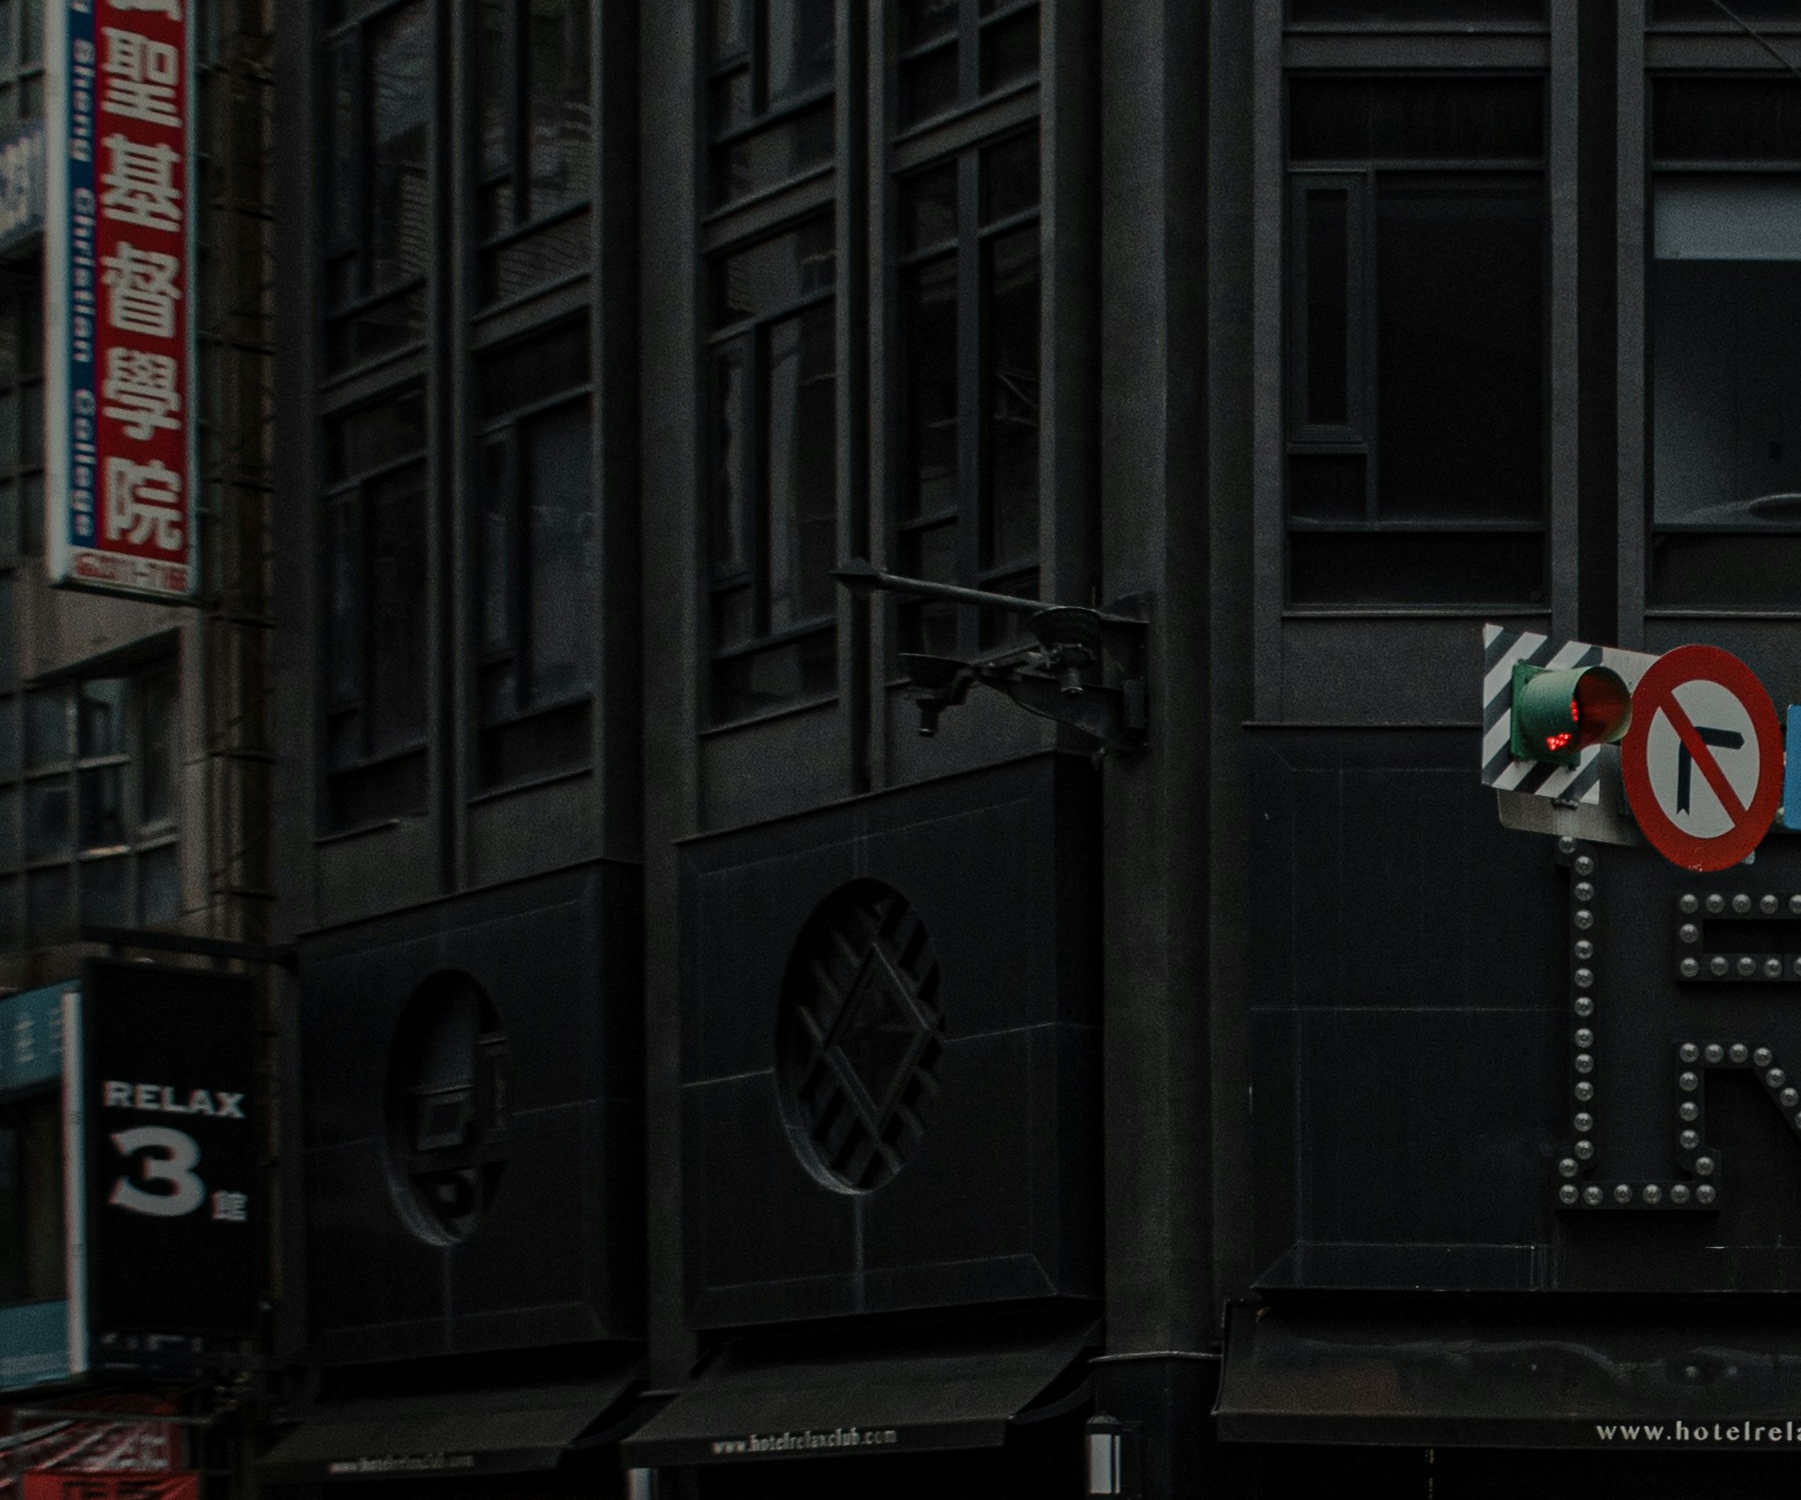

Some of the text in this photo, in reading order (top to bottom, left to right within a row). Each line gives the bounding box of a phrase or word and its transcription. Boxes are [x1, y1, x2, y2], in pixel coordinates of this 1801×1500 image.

[72, 187, 96, 364] Christian
[72, 388, 97, 538] College
[101, 1079, 247, 1119] RELAX
[711, 1427, 898, 1454] www.hotelrelaxclub.com
